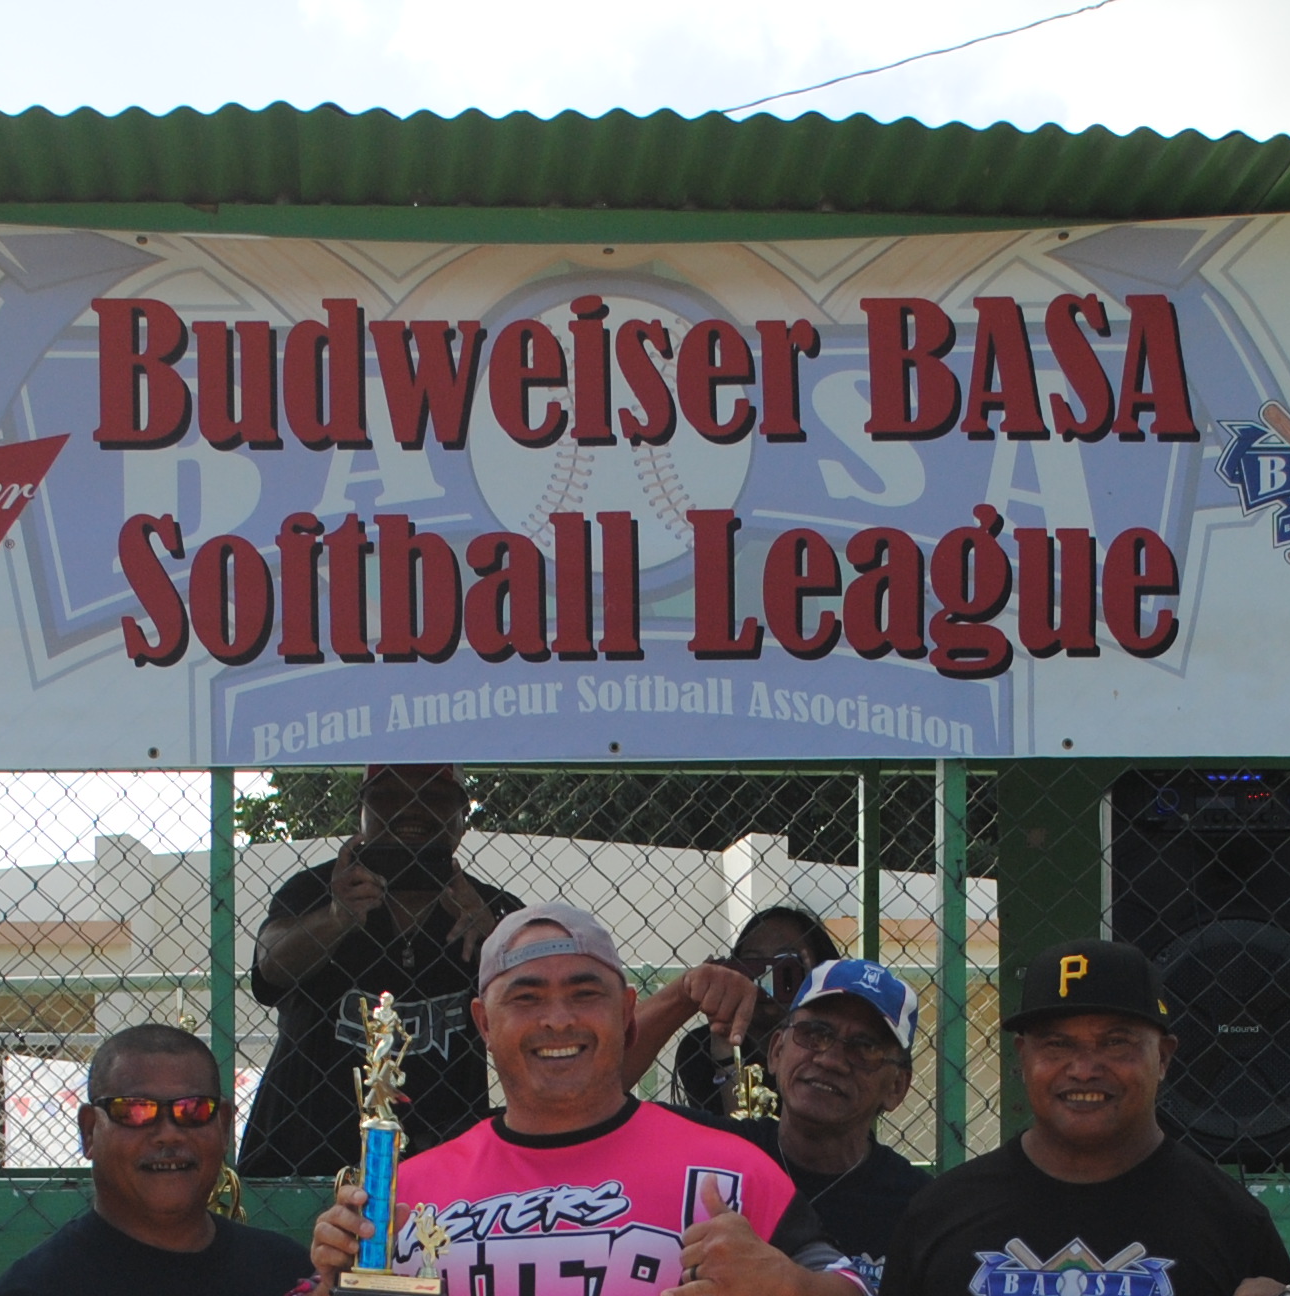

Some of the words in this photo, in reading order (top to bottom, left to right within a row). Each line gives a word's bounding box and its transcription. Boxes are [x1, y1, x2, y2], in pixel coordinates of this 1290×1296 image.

[91, 294, 821, 451] Budweiser
[860, 292, 1200, 443] BASA
[118, 508, 645, 667] Softball
[687, 503, 1180, 679] League
[253, 702, 371, 764] Belau
[385, 679, 564, 734] Amateur
[576, 675, 733, 716] Softball
[748, 678, 975, 756] Association
[1058, 954, 1089, 998] P
